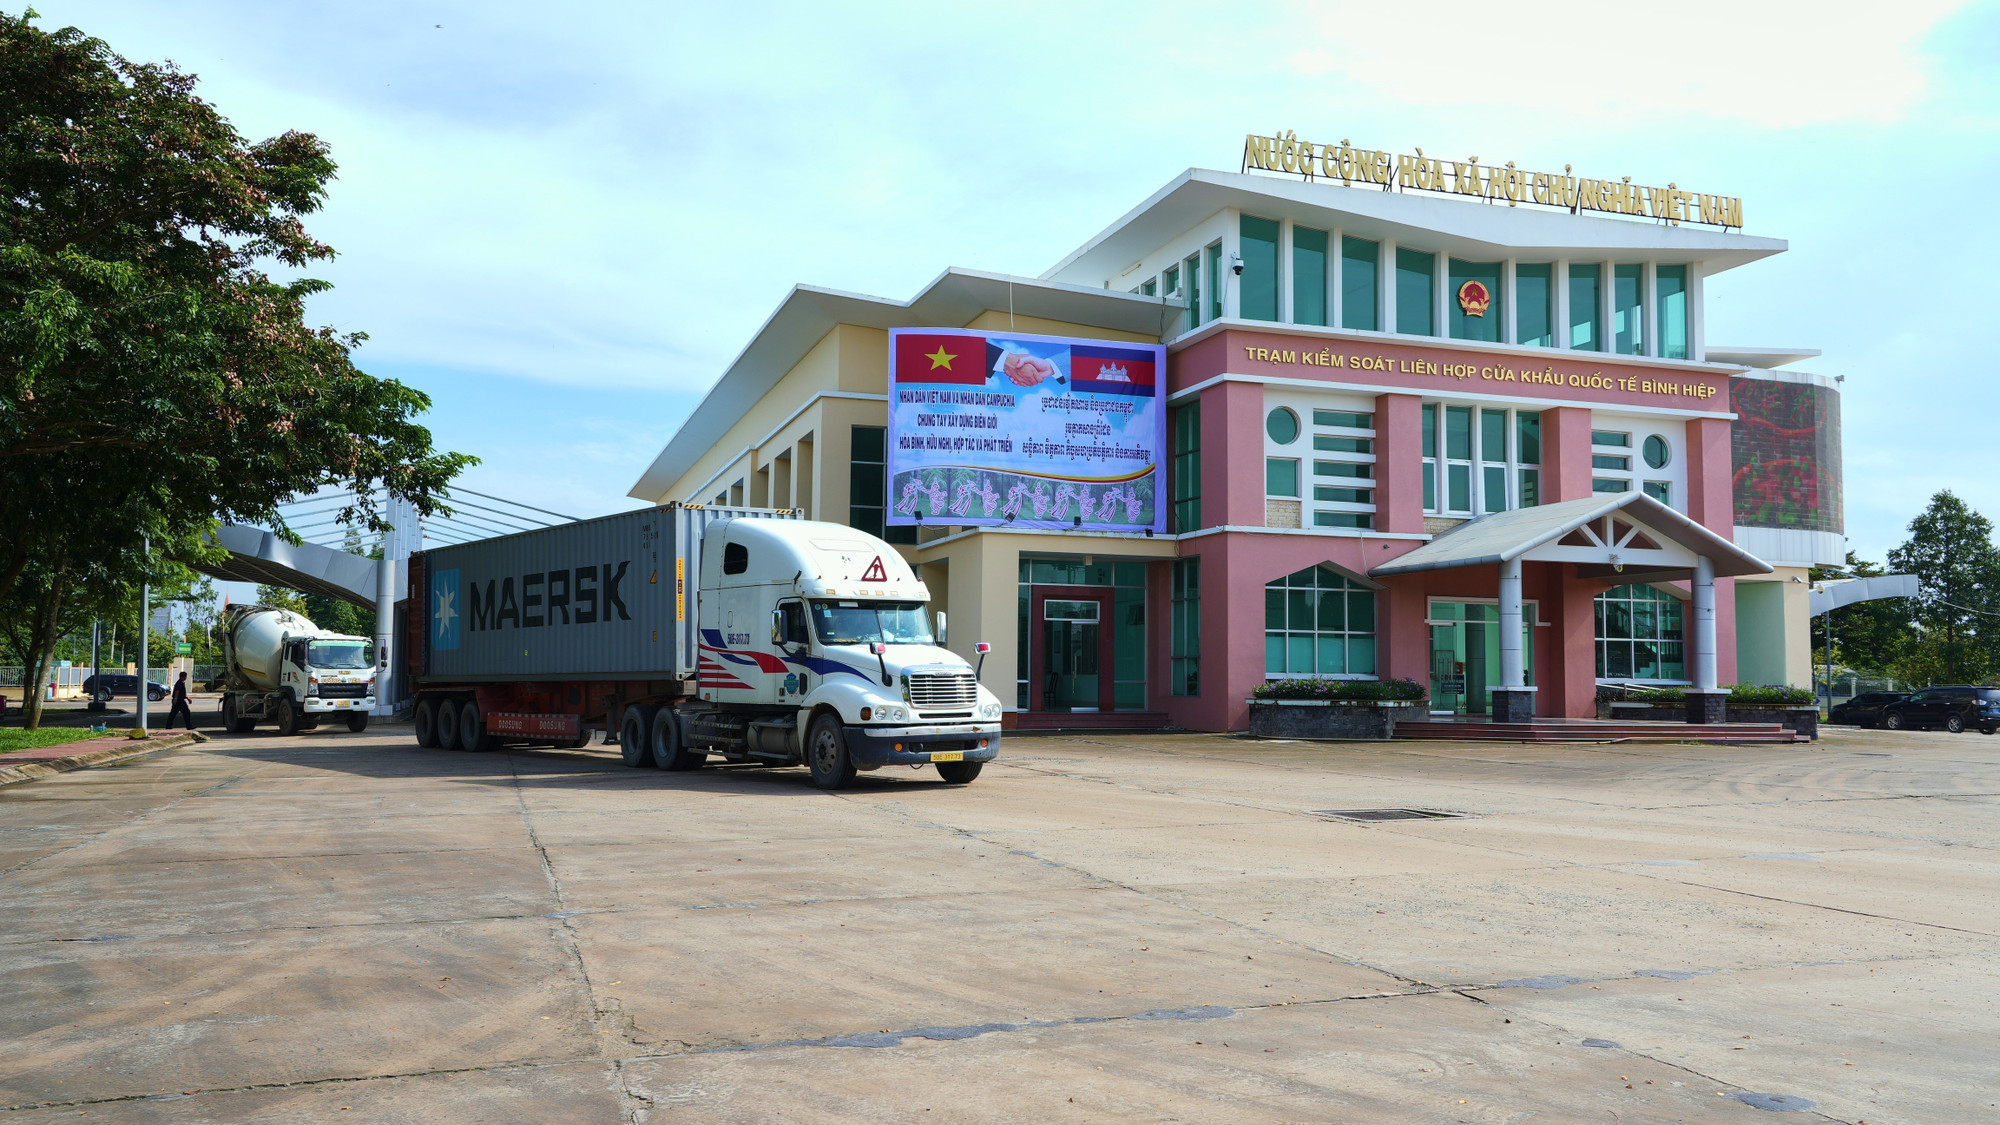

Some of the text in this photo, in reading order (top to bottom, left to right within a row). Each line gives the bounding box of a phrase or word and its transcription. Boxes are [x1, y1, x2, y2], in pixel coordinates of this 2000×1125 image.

[1247, 129, 1744, 228] NƯỚC CỘNG HÒA XÃ HỘI CHỦ NGHĨA VIỆT NAM
[1245, 347, 1717, 400] TRẠM KIỂM SOÁT LIÊN HỢP CỬA KHẨU QUỐC TẾ BÌNH HIỆP
[899, 388, 914, 404] NHÂN
[915, 388, 926, 404] DÂN
[927, 387, 939, 408] VIỆT
[940, 391, 951, 404] NAM
[952, 388, 959, 404] VÀ
[960, 389, 974, 405] NHÂN
[975, 389, 986, 406] DÂN
[917, 412, 998, 431] CHUNG TAY XÂY DỰNG BIÊN GIỚI
[899, 433, 910, 450] HÒA
[953, 435, 964, 454] HỢP
[965, 434, 975, 451] TÁC
[976, 435, 983, 451] VÀ
[983, 435, 997, 452] PHÁT
[998, 433, 1013, 453] TRIỂN
[470, 560, 632, 632] MAERSK
[498, 719, 523, 730] DOOSUNG
[539, 720, 566, 731] DOOSUNG
